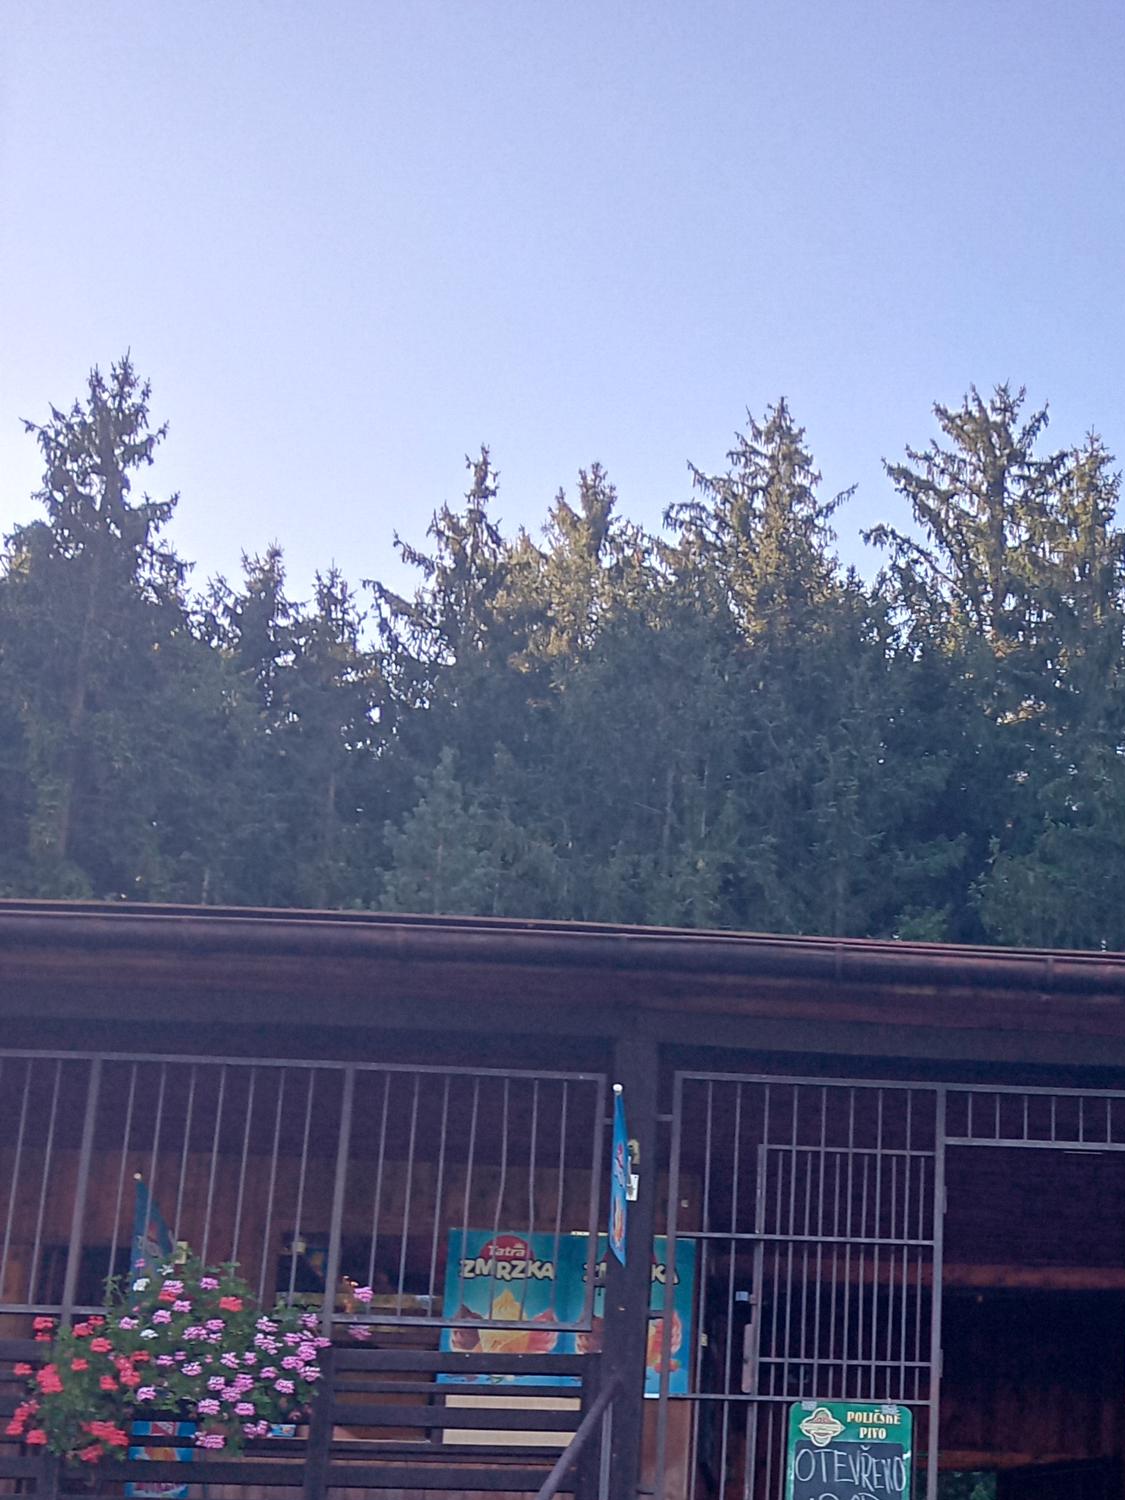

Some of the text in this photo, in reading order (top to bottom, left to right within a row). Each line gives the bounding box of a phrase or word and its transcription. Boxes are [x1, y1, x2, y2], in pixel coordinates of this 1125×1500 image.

[459, 1257, 554, 1281] ZMRZKA
[858, 1426, 887, 1440] PIVO
[795, 1444, 907, 1494] OTEVŘENO
